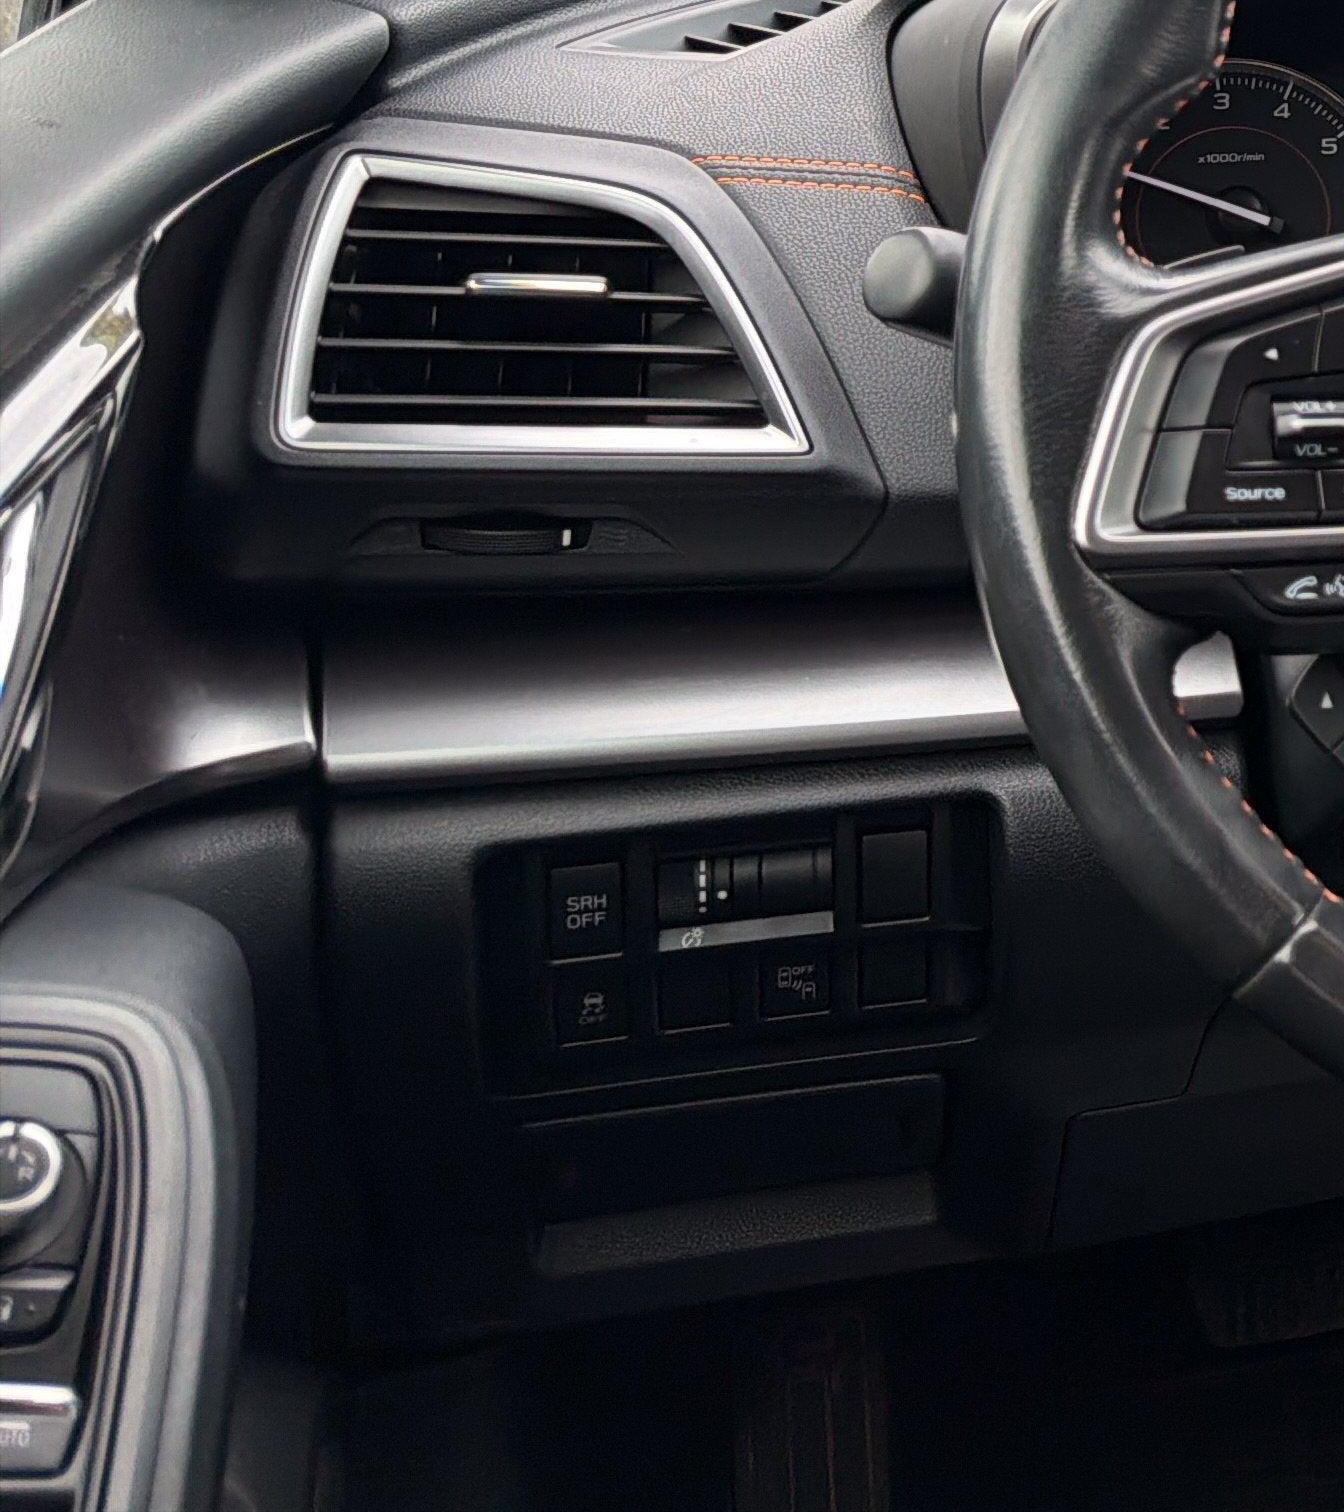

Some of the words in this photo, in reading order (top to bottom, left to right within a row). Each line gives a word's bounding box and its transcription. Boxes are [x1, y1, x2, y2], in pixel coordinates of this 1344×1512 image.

[1212, 92, 1231, 109] 3
[1273, 101, 1292, 119] 4
[1320, 137, 1338, 155] 5
[1225, 486, 1286, 501] Source
[566, 894, 607, 913] SRH
[566, 911, 607, 930] OFF
